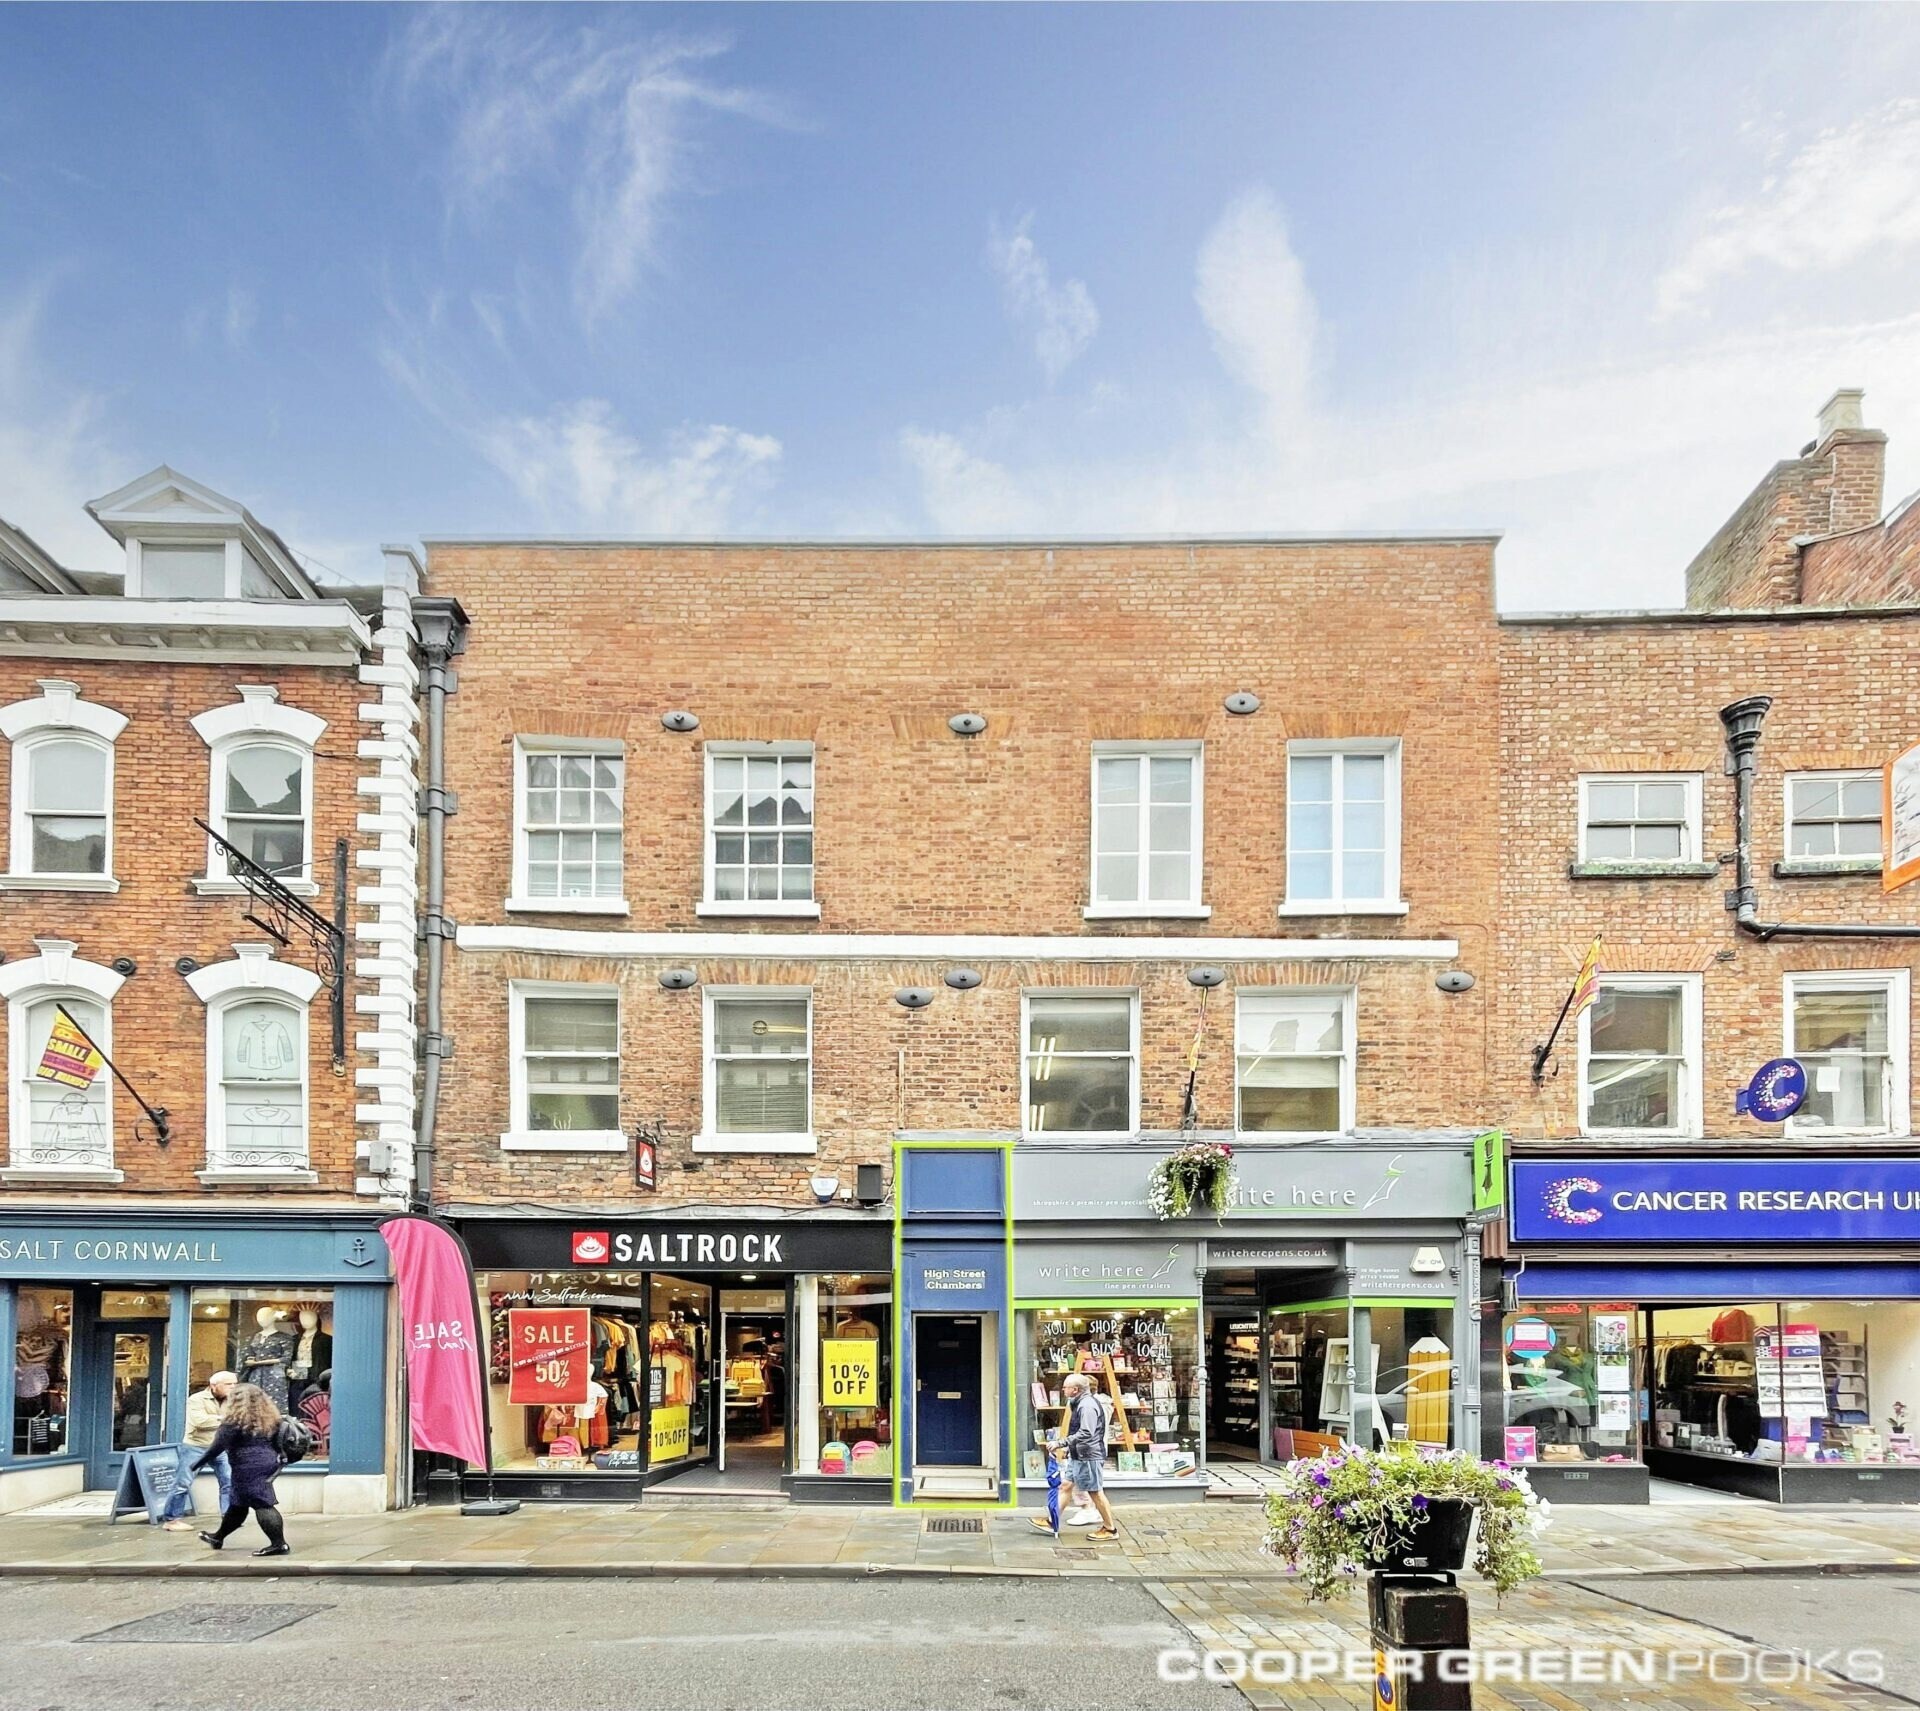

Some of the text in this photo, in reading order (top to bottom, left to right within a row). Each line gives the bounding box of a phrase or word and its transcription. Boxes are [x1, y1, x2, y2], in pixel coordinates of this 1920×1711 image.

[47, 1038, 87, 1060] SMALL
[1291, 1184, 1357, 1205] here
[1611, 1190, 1728, 1211] CANCER
[1738, 1190, 1884, 1211] RESEARCH
[0, 1239, 223, 1262] SALT CORNWALL
[614, 1233, 783, 1263] SALTROCK
[1212, 1247, 1328, 1259] writeherepens.co.uk
[924, 1269, 986, 1280] High Street
[1038, 1263, 1145, 1278] write here
[926, 1281, 983, 1290] Chambers
[1360, 1281, 1446, 1290] writeherepens.co.uk
[523, 1324, 575, 1344] SALE
[1044, 1319, 1169, 1336] YOU SHOP LOCAL
[1049, 1341, 1172, 1363] WE BUY LOCAL
[535, 1359, 570, 1384] 50%
[830, 1364, 870, 1379] 10%
[833, 1380, 867, 1395] OFF
[654, 1427, 688, 1448] 10% OFF
